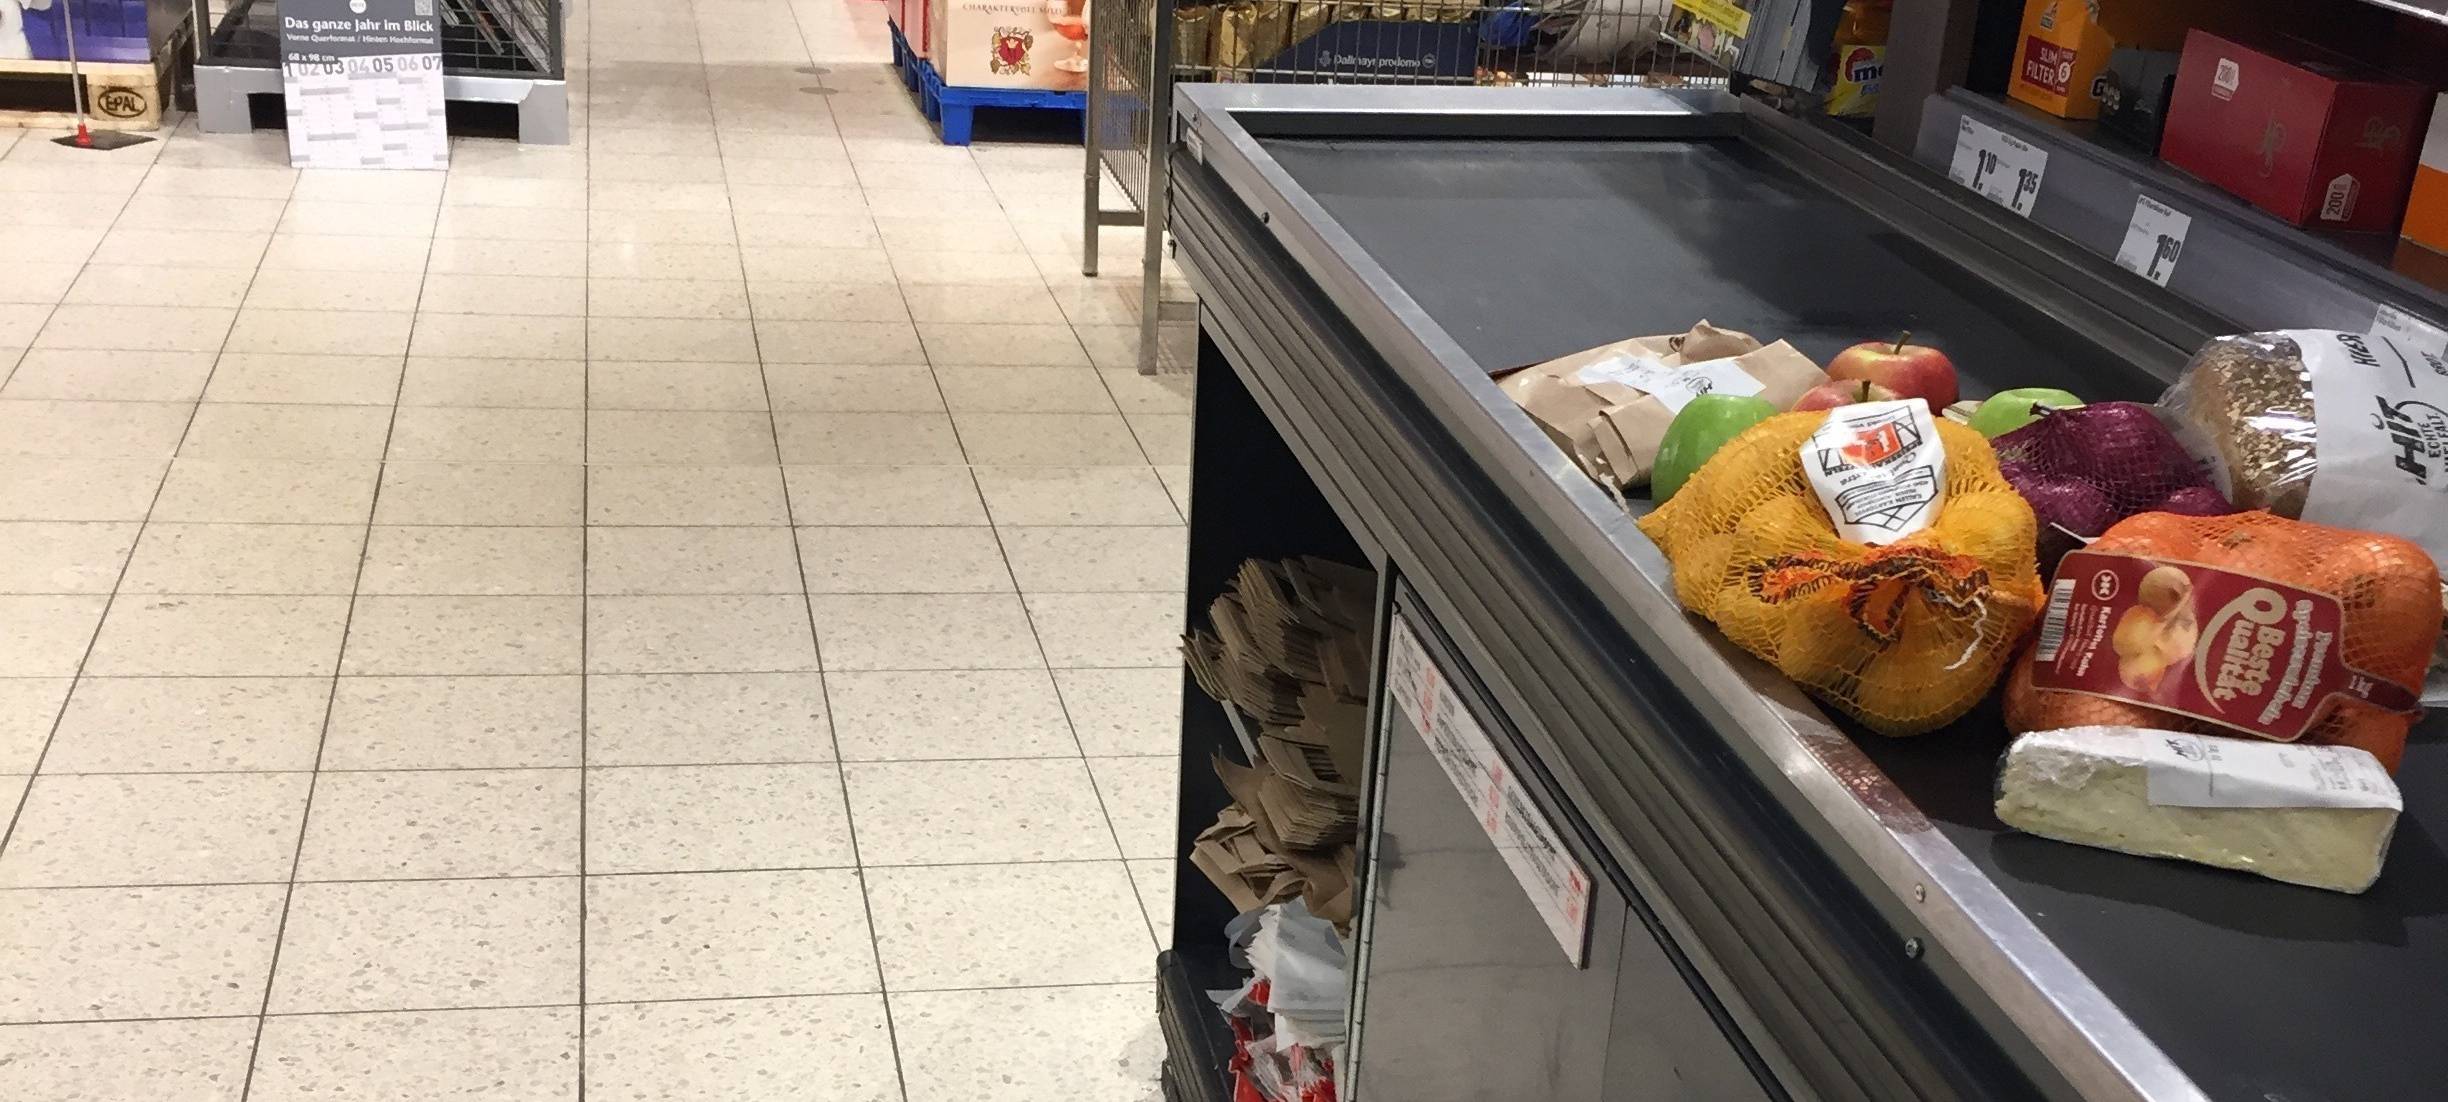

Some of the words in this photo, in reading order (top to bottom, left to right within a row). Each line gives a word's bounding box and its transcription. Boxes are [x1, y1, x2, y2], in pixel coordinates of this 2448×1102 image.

[284, 16, 309, 29] Das
[312, 19, 352, 33] ganze
[355, 18, 381, 33] Jahr
[384, 18, 401, 31] im
[403, 20, 434, 32] Blick
[323, 60, 345, 75] 03
[372, 57, 394, 73] 05
[397, 56, 419, 72] 06
[421, 55, 442, 71] 07
[2026, 60, 2056, 86] FILTER
[105, 95, 141, 112] EPAL
[2417, 422, 2442, 458] ECHTE
[2239, 624, 2286, 696] Beste
